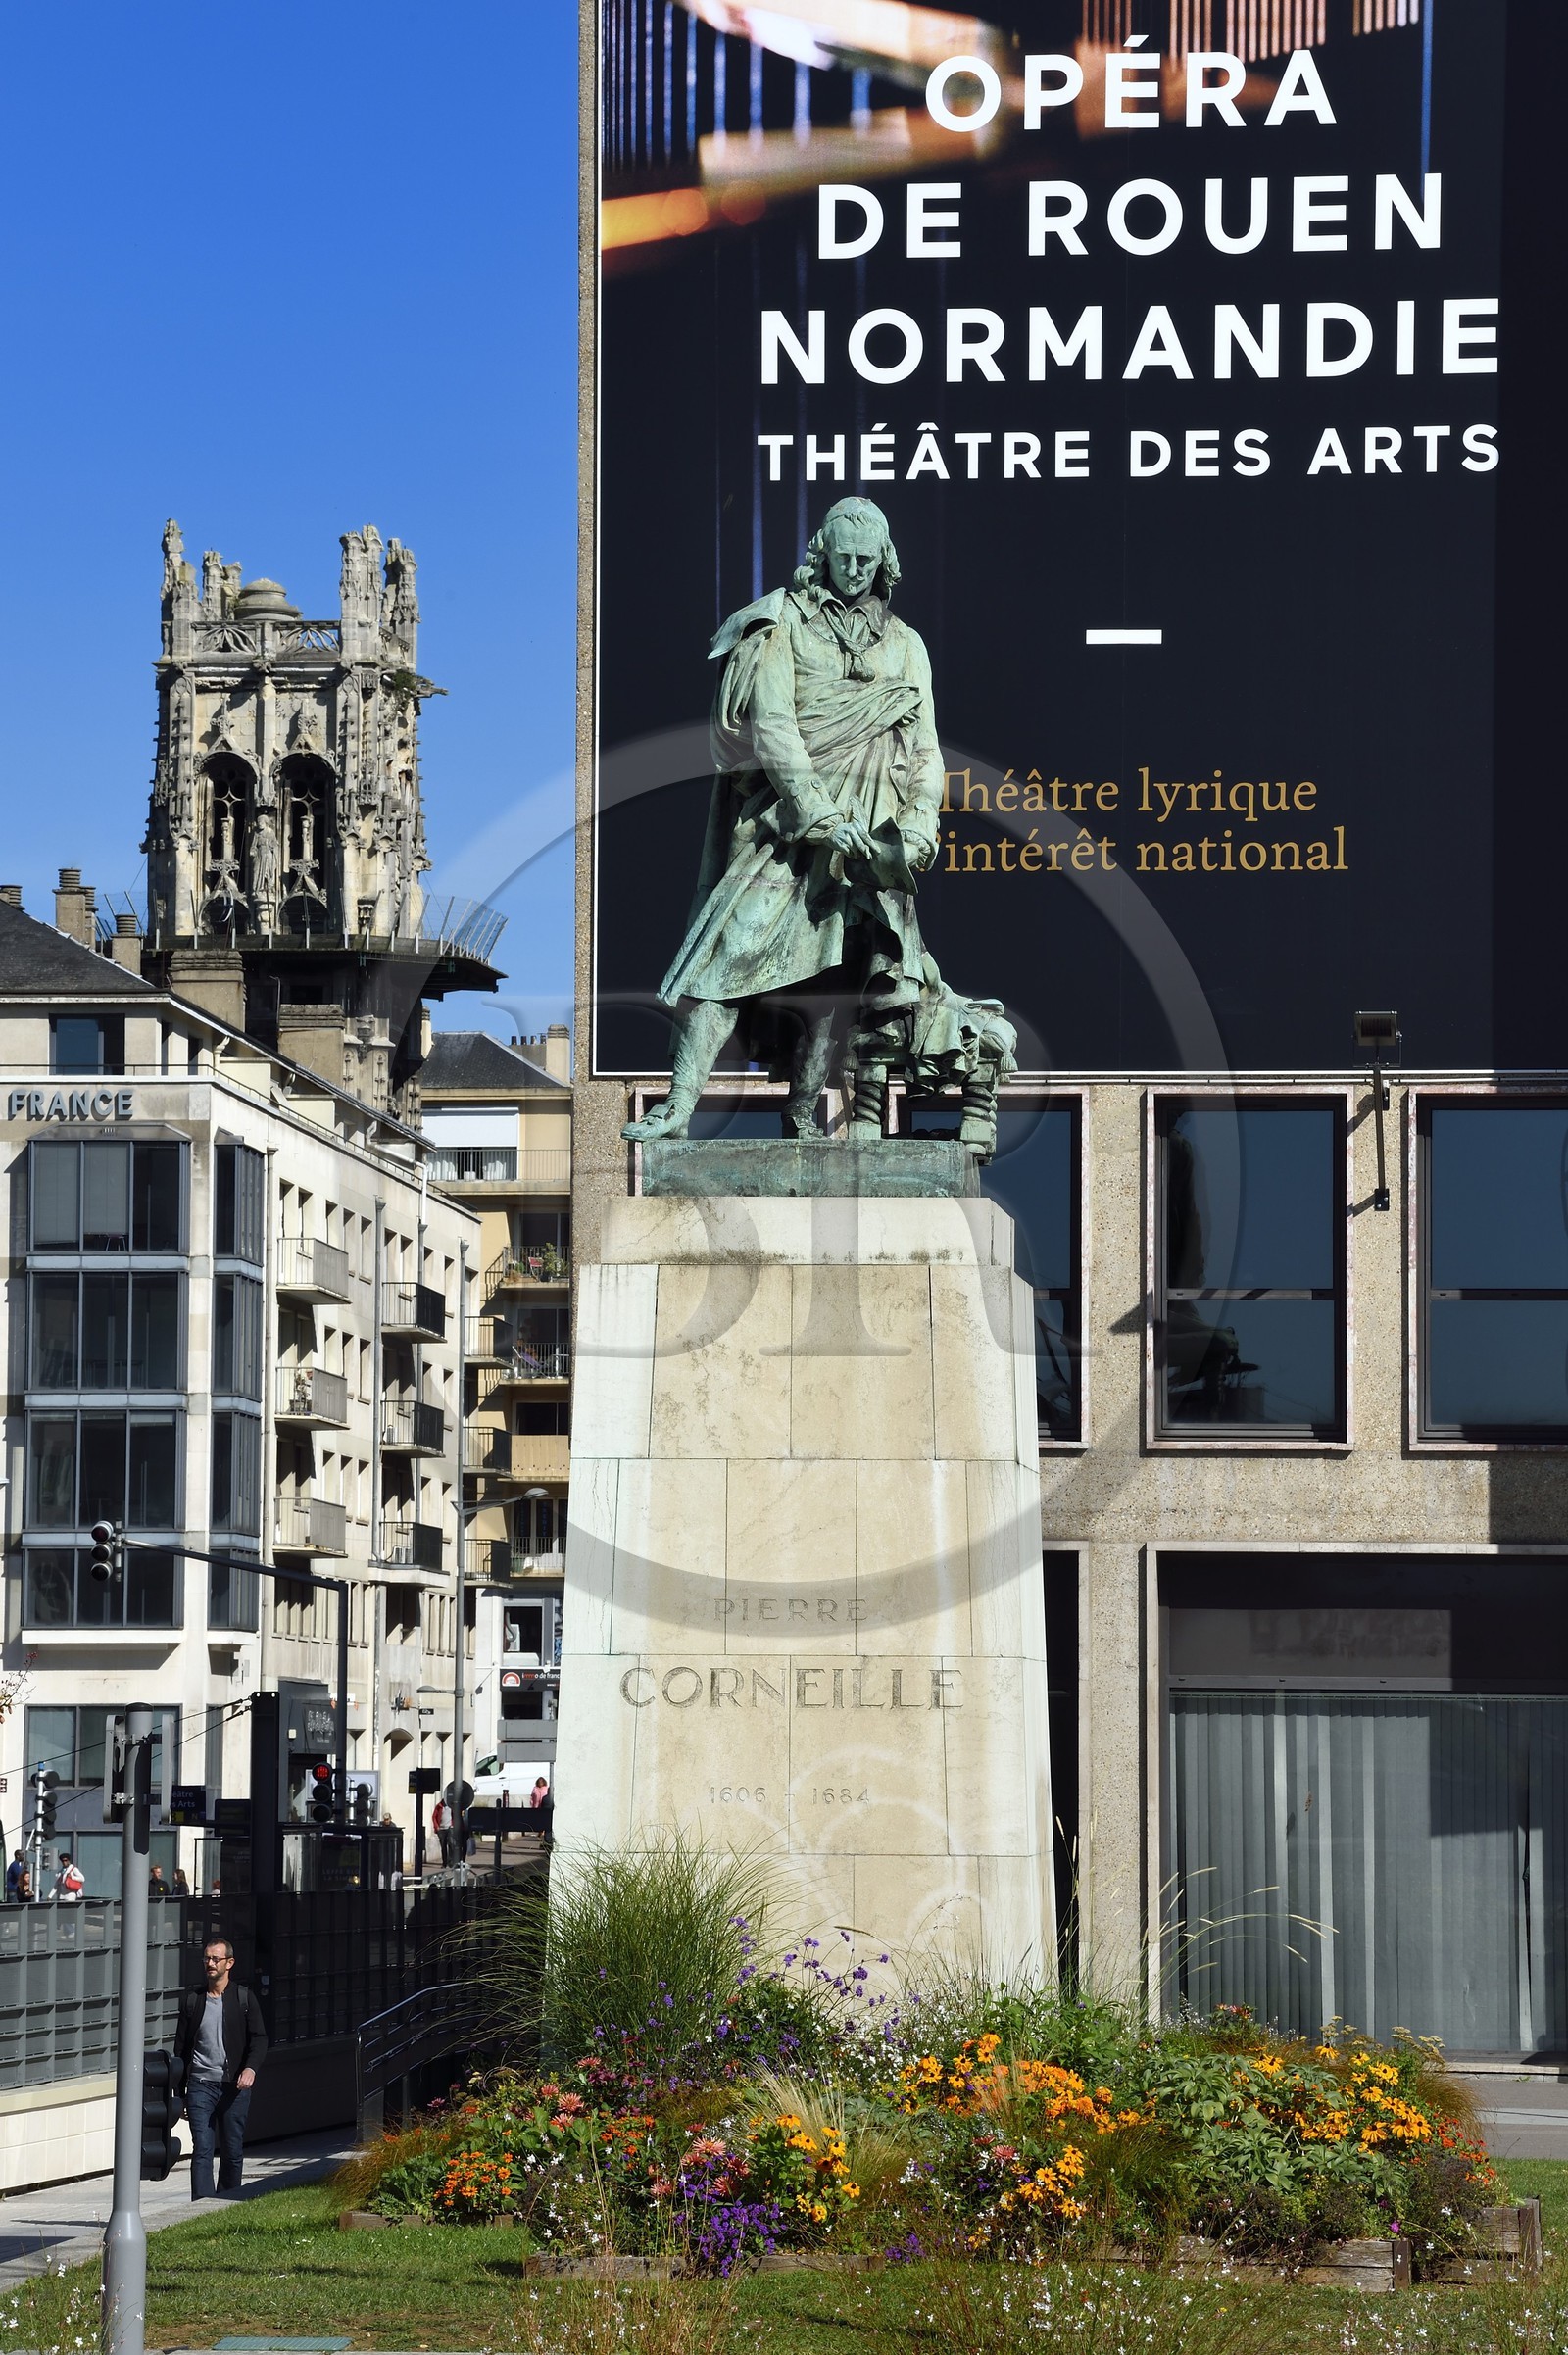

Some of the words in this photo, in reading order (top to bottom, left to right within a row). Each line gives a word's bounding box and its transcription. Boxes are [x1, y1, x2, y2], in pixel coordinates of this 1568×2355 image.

[925, 34, 1338, 133] OPÉRA
[817, 181, 962, 261] DE
[1027, 172, 1444, 257] ROUEN
[760, 298, 1500, 385] NORMANDIE
[757, 421, 1091, 482] THÉÂTRE
[1129, 428, 1272, 478] DES
[1306, 423, 1500, 476] ARTS
[1139, 766, 1317, 823] lyrique
[1137, 825, 1348, 872] national
[9, 1090, 133, 1120] FRANCE
[713, 1598, 868, 1621] PIERRE
[619, 1666, 964, 1709] CORNEILLE
[710, 1786, 766, 1804] 1606
[812, 1787, 870, 1805] 1684
